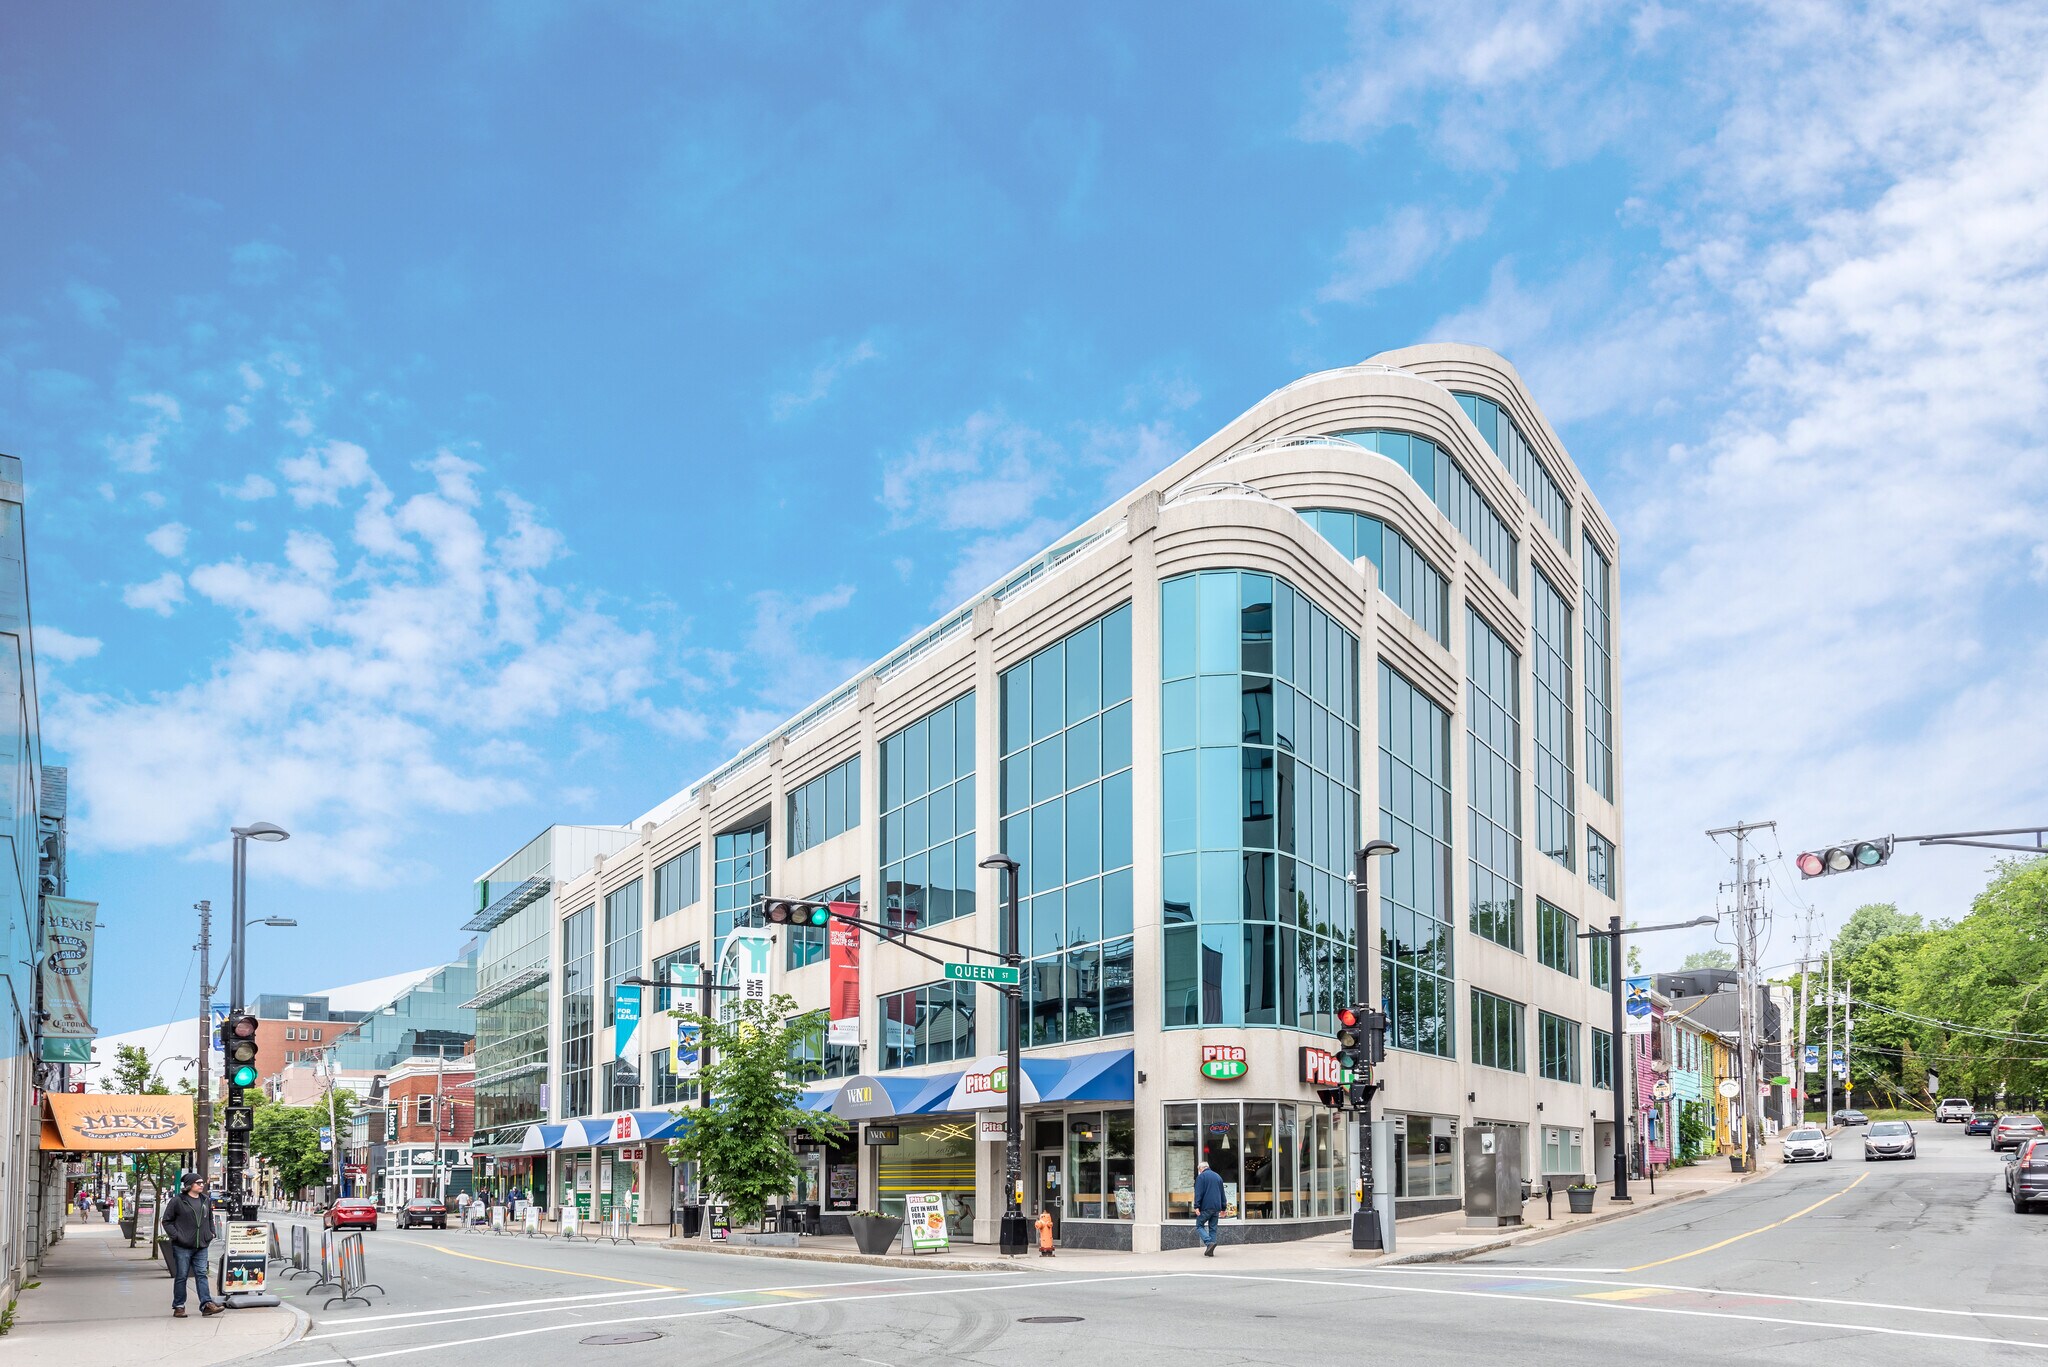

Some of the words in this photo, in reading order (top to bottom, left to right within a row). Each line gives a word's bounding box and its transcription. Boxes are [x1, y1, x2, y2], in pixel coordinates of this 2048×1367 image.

[57, 936, 82, 947] TACOS
[954, 965, 995, 979] QUEEN
[755, 979, 763, 997] NFB
[63, 1043, 71, 1056] THE
[1202, 1045, 1245, 1061] Pita
[1210, 1061, 1239, 1076] Pit
[1305, 1047, 1341, 1085] Pita
[965, 1073, 992, 1094] Pita
[993, 1071, 1008, 1089] Pi
[389, 1109, 397, 1135] Roots
[982, 1122, 1003, 1132] Pita
[1209, 1124, 1230, 1132] OPEN
